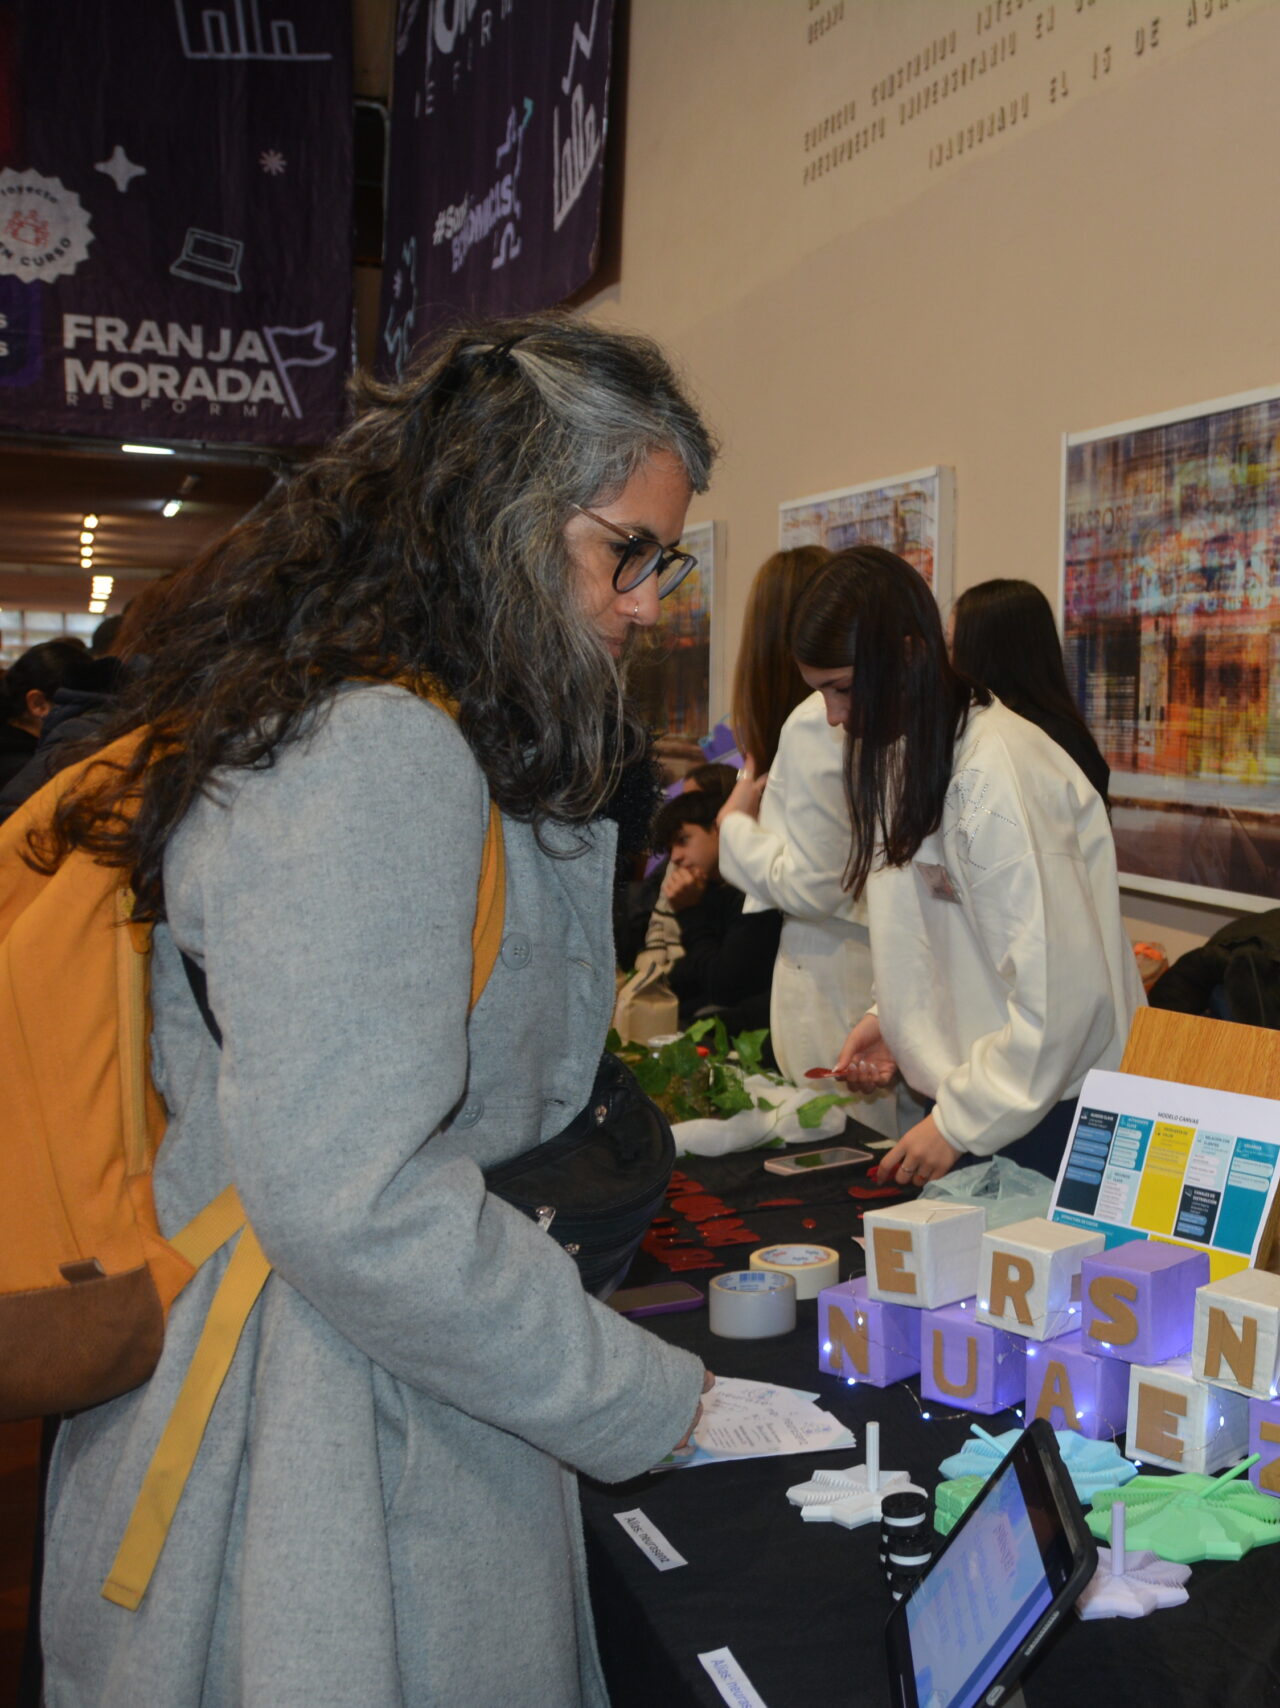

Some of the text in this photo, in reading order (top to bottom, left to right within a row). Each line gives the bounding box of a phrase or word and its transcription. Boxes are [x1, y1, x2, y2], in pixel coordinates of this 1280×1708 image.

[1135, 17, 1160, 57] DE
[20, 237, 72, 267] CURSO
[63, 313, 269, 363] FRANJA
[64, 357, 286, 404] MORADA
[66, 393, 291, 419] REFORMA
[1157, 1111, 1179, 1121] MODELO
